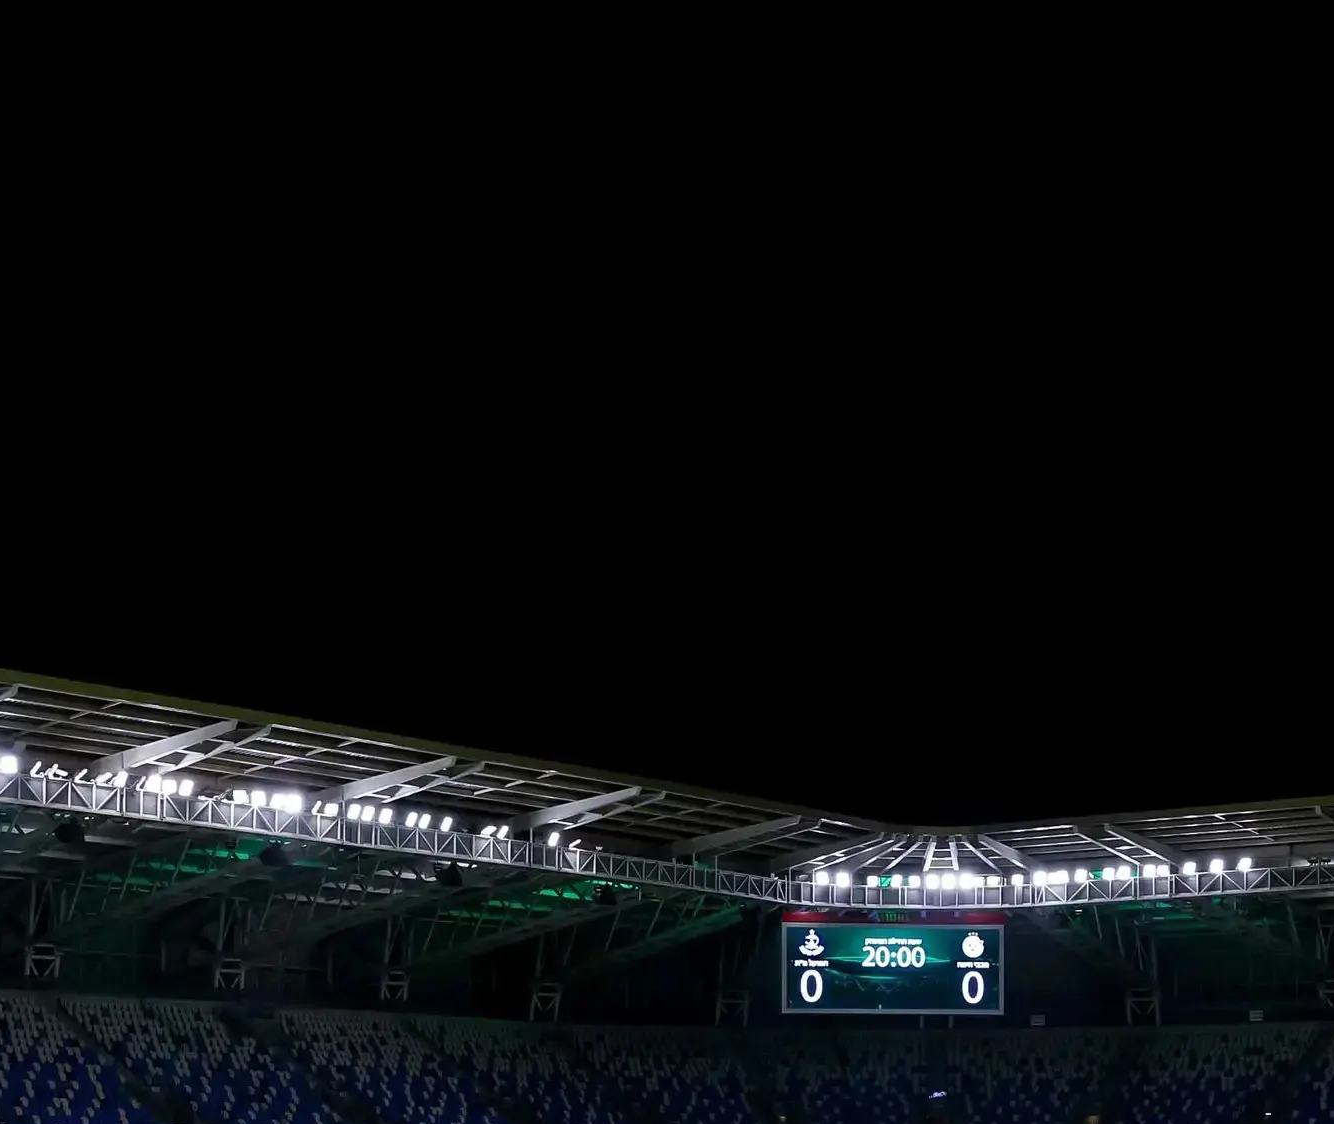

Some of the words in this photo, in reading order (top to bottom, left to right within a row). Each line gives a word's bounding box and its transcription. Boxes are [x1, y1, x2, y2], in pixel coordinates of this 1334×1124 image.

[862, 946, 925, 968] 20:00
[800, 969, 823, 1003] 0
[962, 971, 985, 1004] 0
